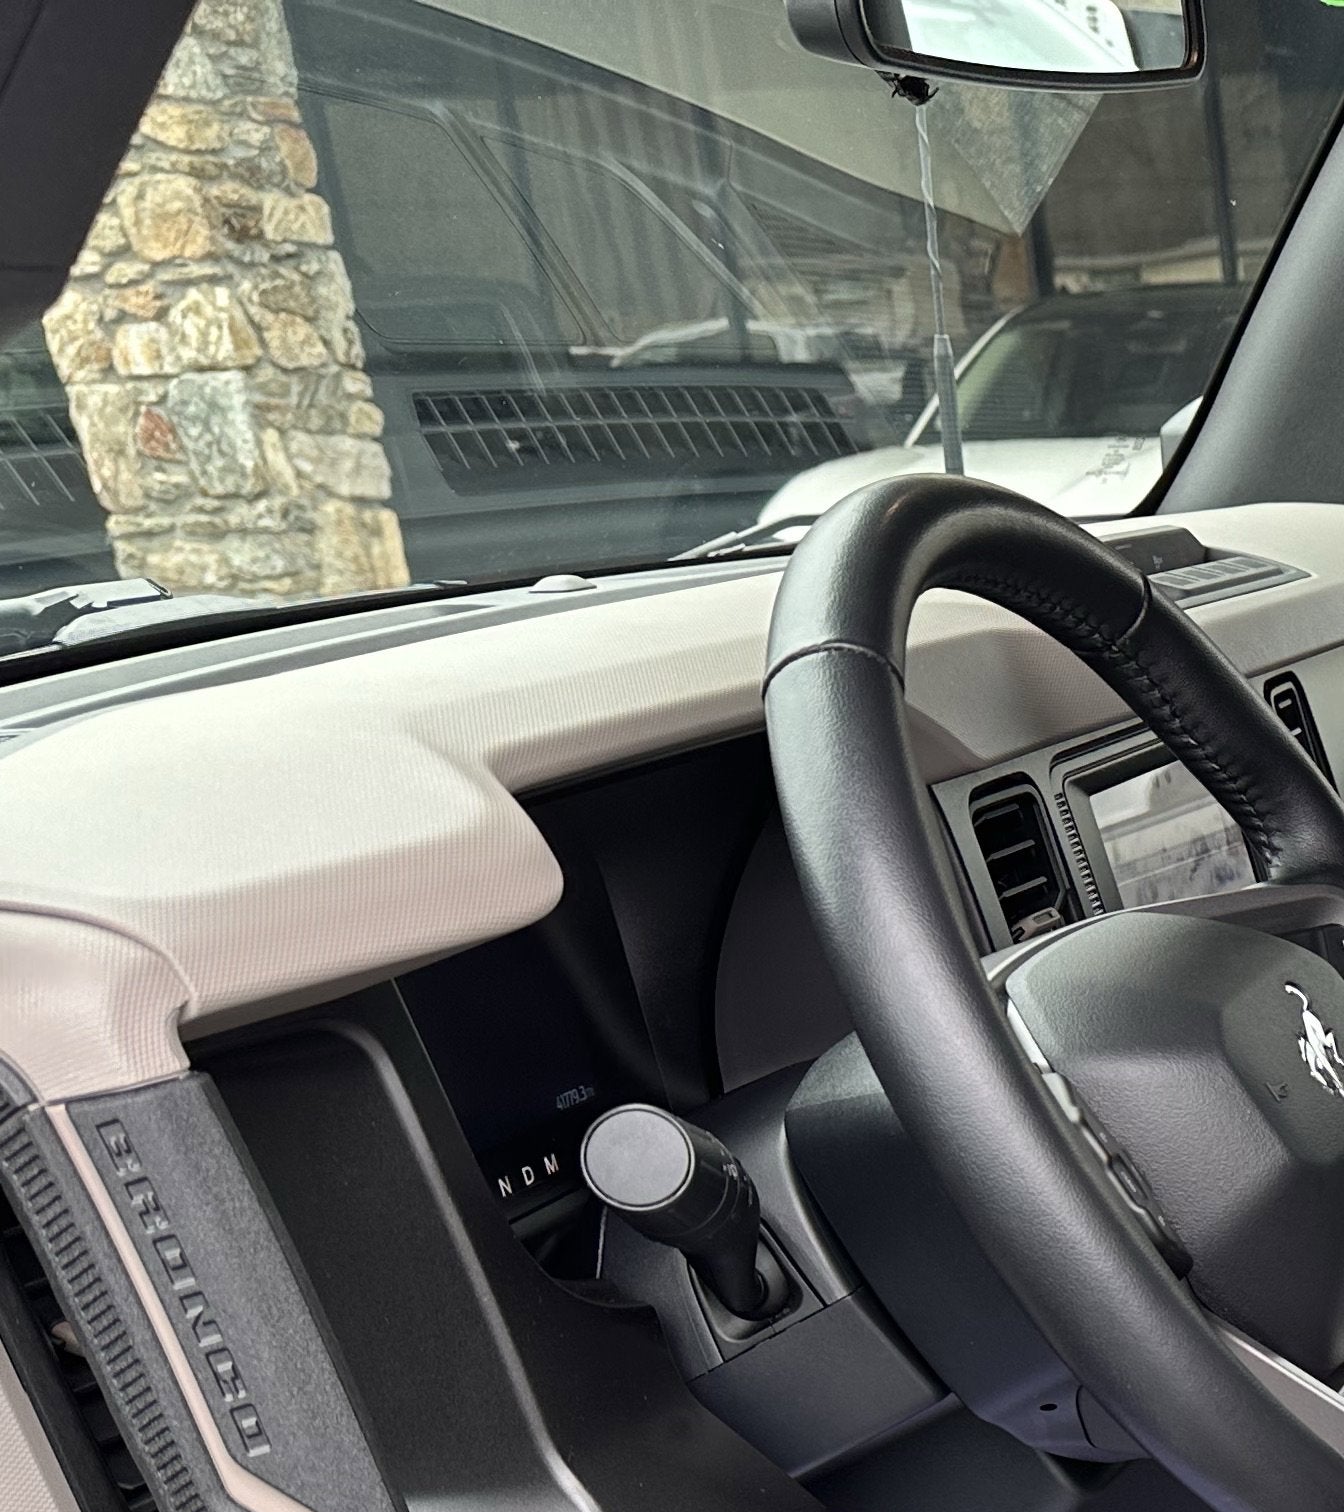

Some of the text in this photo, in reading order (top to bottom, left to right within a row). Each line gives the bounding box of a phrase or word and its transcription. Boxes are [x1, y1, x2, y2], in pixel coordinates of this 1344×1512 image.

[497, 1153, 560, 1198] N D M
[94, 1117, 272, 1459] BRONCO
